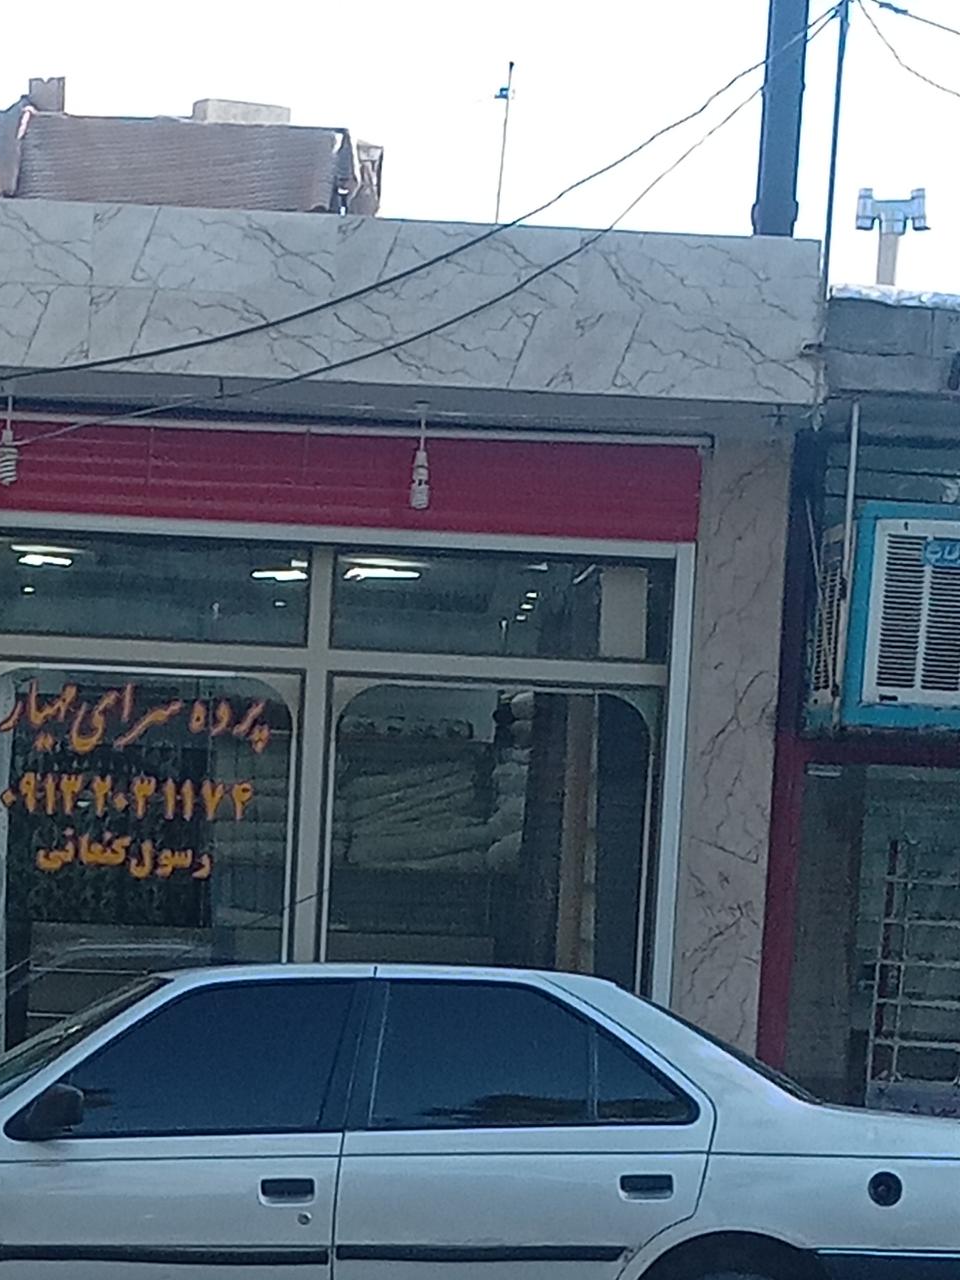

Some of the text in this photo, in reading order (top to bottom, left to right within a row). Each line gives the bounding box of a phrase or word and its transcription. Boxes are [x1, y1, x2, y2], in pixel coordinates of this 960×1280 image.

[70, 681, 185, 752] سرای
[35, 827, 213, 879] رسول کنعانی
